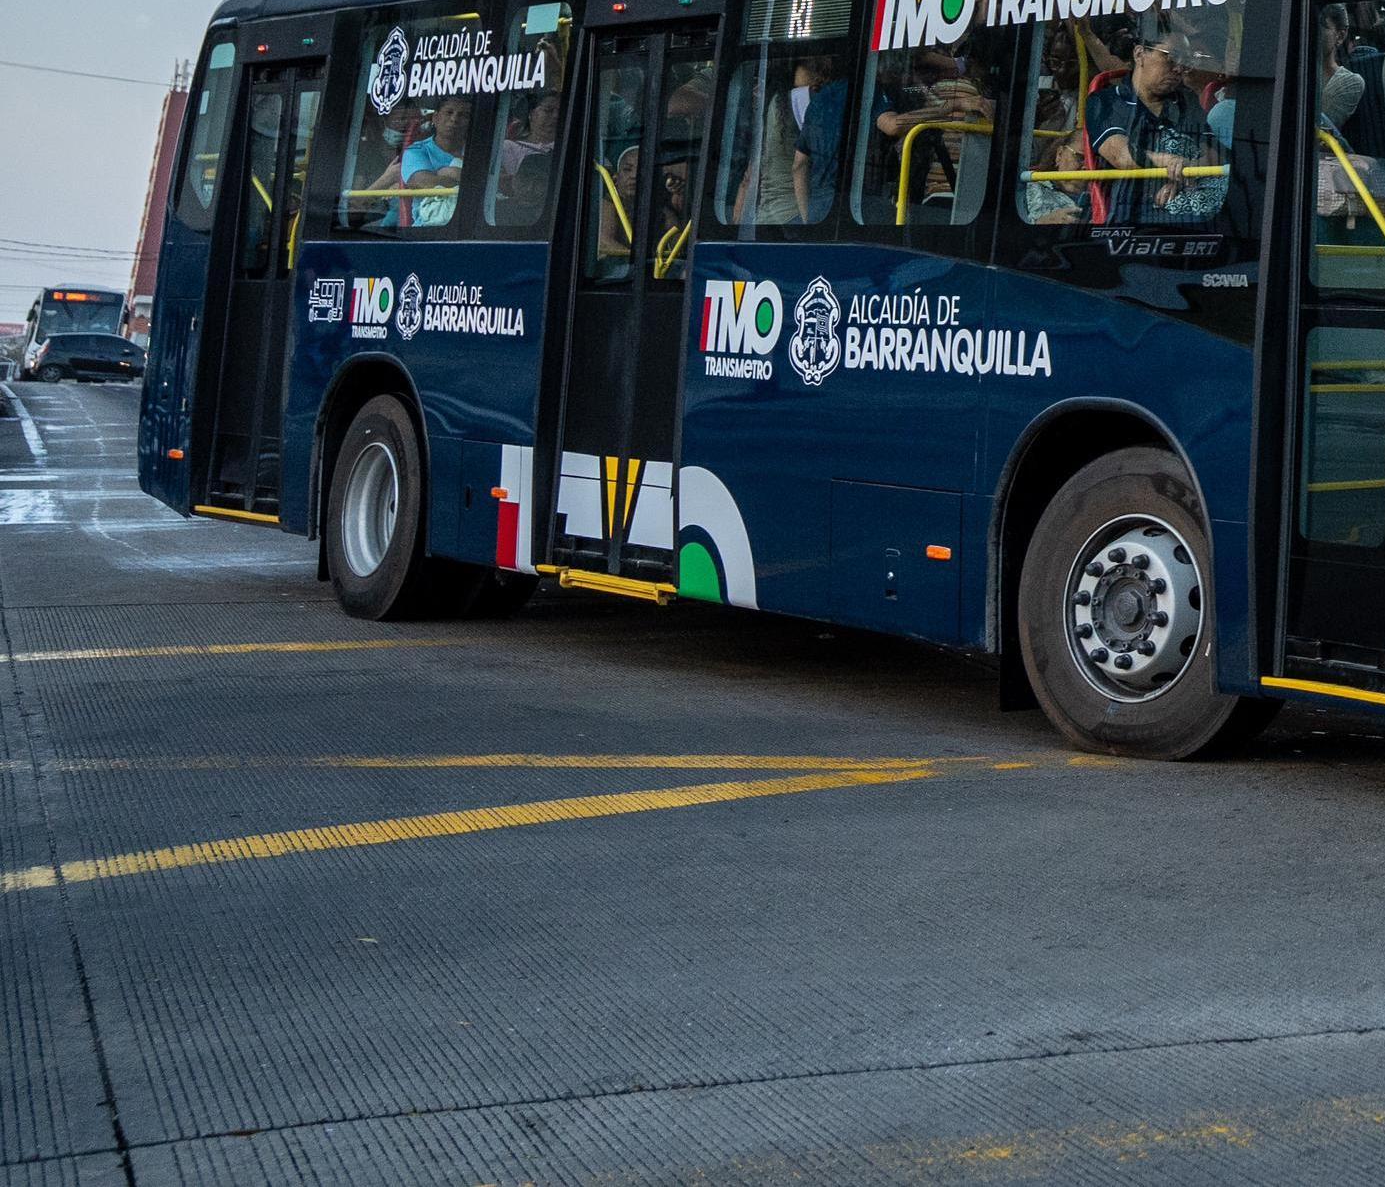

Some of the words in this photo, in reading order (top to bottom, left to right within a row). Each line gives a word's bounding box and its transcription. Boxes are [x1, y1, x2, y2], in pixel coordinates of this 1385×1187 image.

[413, 27, 471, 61] ALCALDÍA
[474, 30, 493, 56] DE
[408, 51, 545, 97] BARRANQUILLA
[1091, 229, 1132, 238] GRAN
[1107, 238, 1177, 256] Viale
[1182, 241, 1219, 256] BRT
[426, 281, 468, 305] ALCALDÍA
[469, 285, 483, 306] DE
[1202, 273, 1249, 288] SCANIA
[350, 276, 394, 324] TMO
[700, 279, 784, 354] TMO
[847, 287, 930, 325] ALCALDÍA
[937, 295, 961, 326] DE
[423, 306, 525, 337] BARRANQUILLA
[845, 327, 1052, 377] BARRANQUILLA
